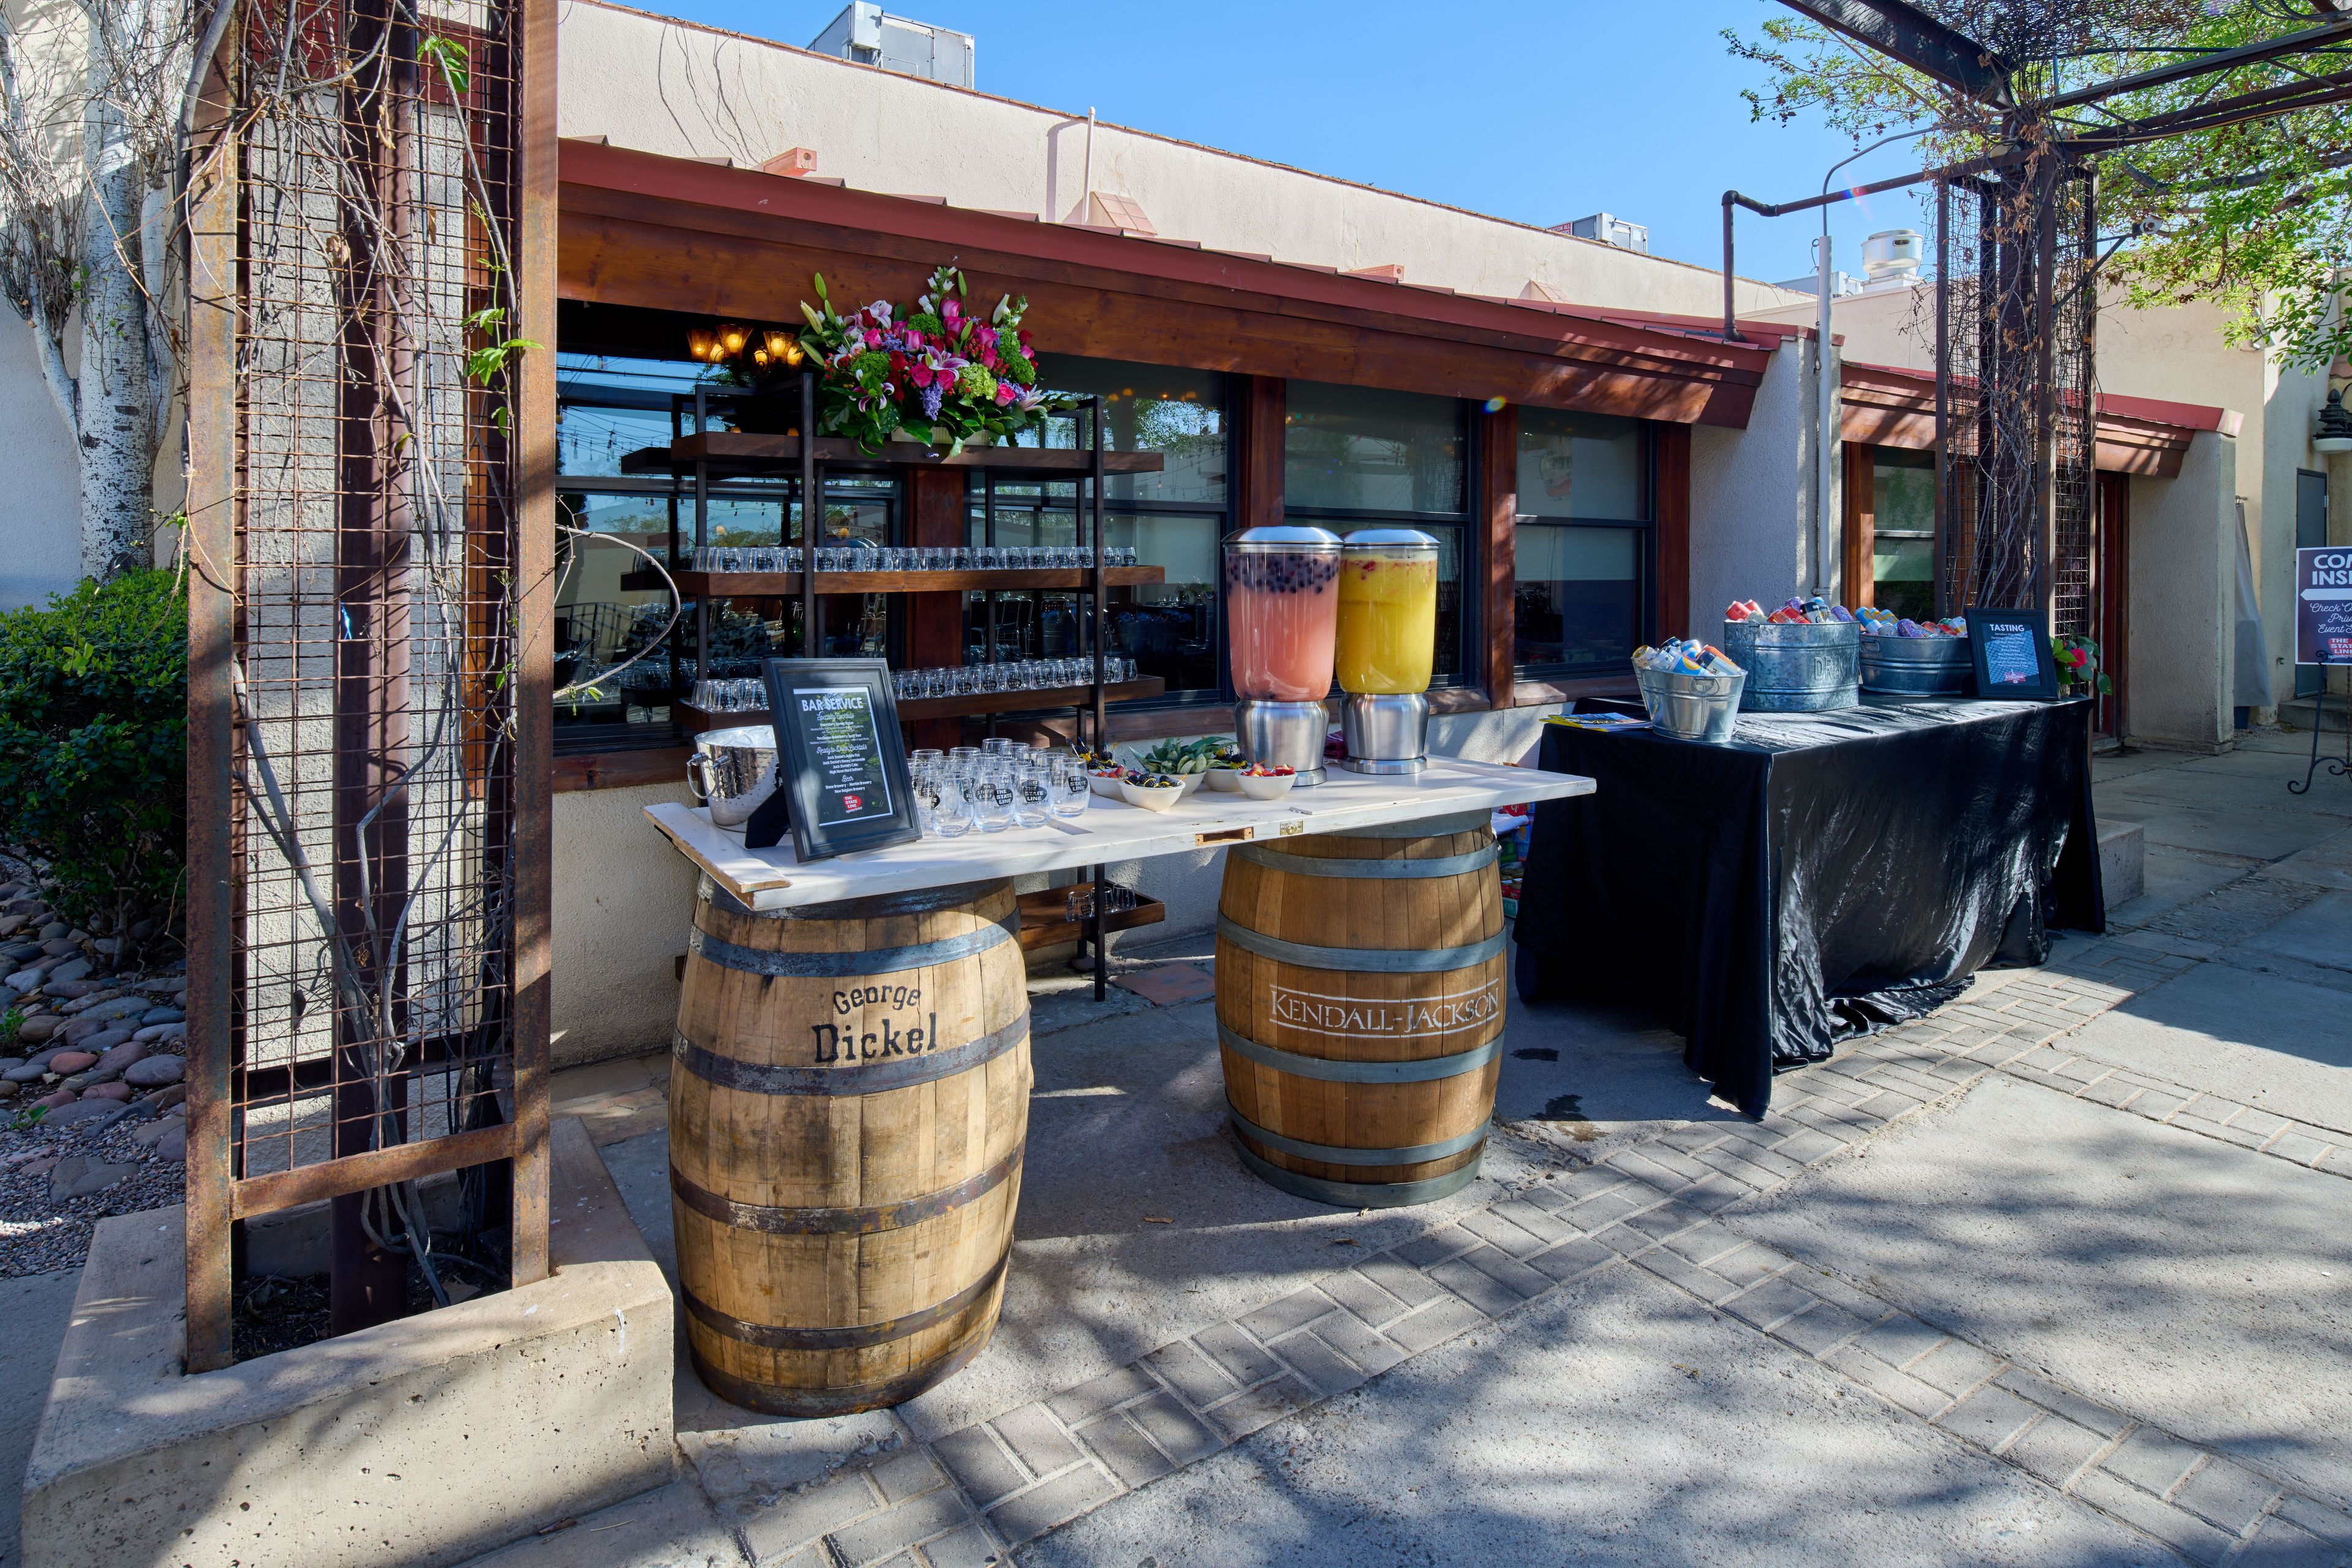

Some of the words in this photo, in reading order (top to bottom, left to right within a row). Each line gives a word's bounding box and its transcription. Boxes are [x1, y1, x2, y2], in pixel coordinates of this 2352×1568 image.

[2310, 603, 2341, 612] Check
[2318, 624, 2345, 633] Event
[801, 699, 824, 711] BAR
[823, 698, 864, 710] SERVICE
[816, 746, 831, 755] Ready
[833, 986, 922, 1015] George
[1272, 987, 1499, 1033] KENDALL-JACKSON
[812, 1012, 937, 1063] Dickel
